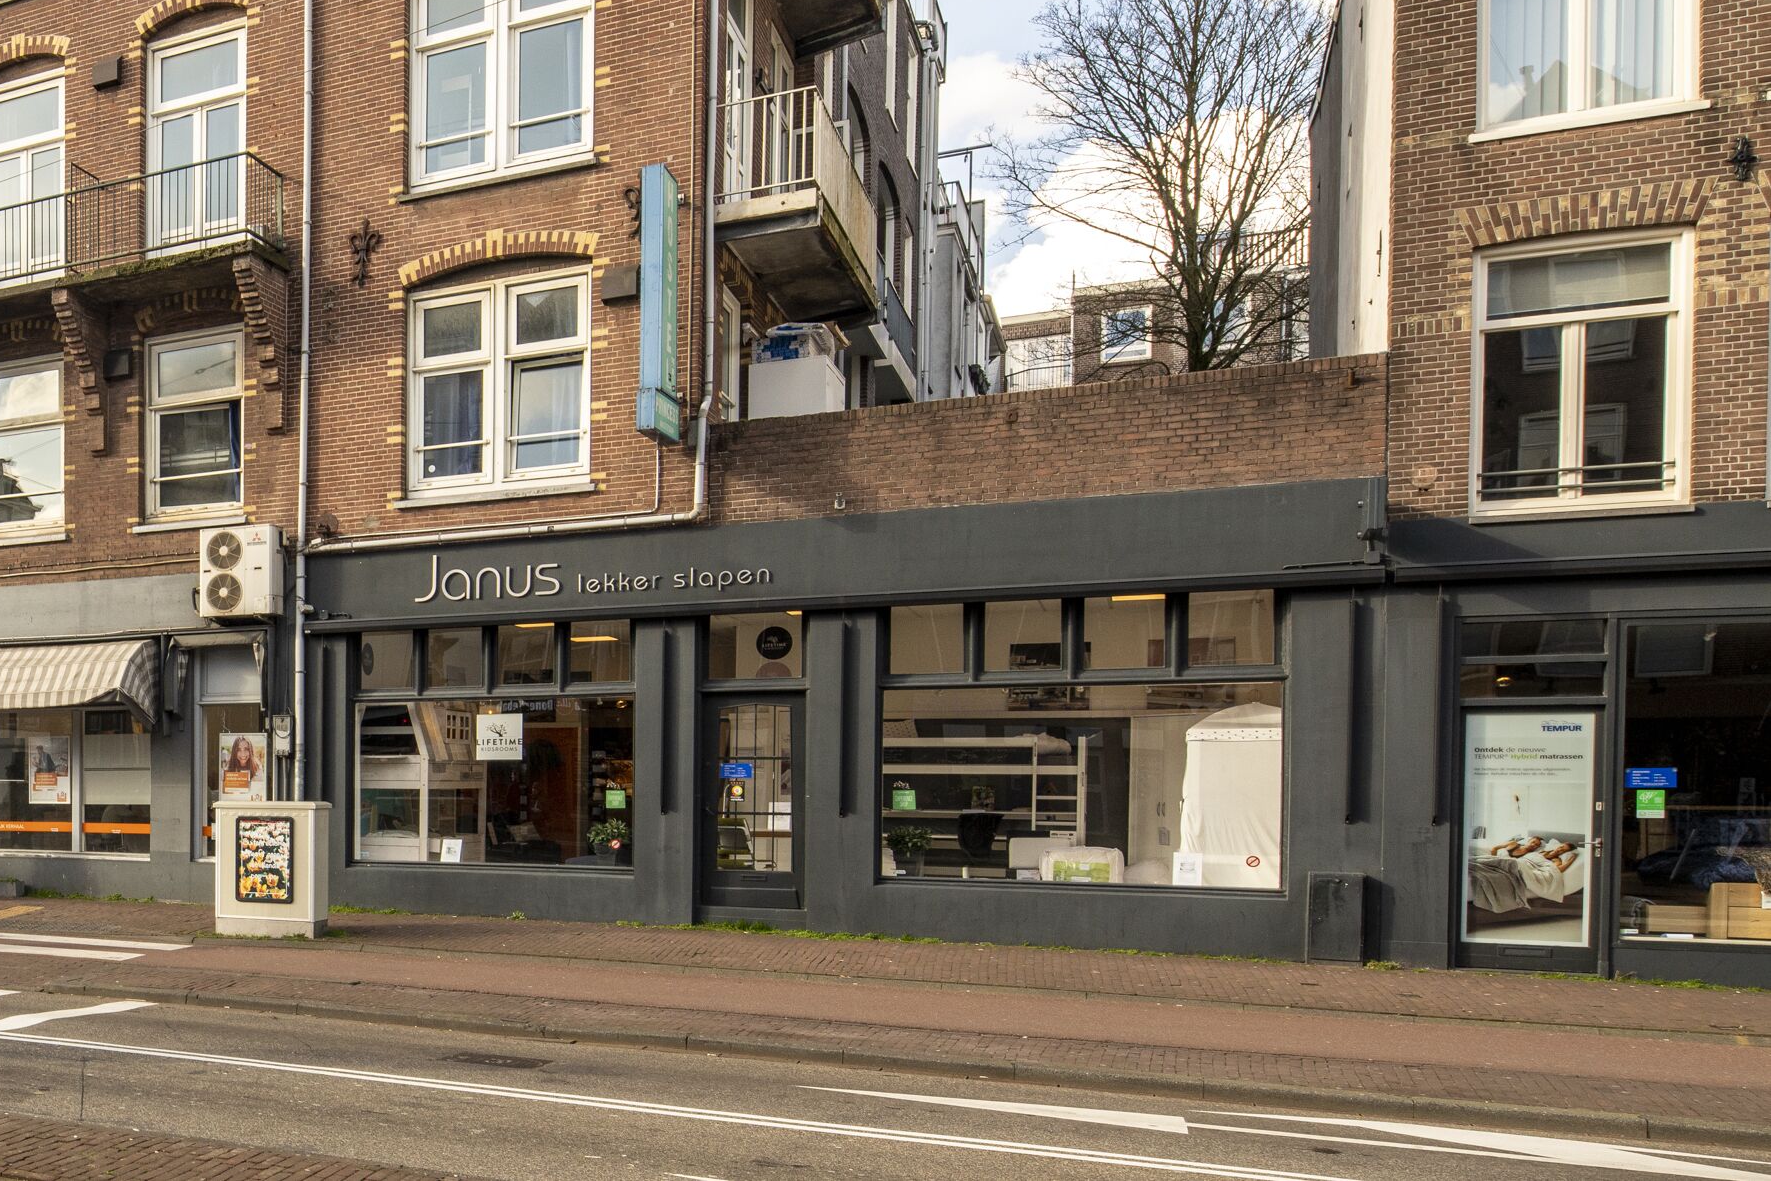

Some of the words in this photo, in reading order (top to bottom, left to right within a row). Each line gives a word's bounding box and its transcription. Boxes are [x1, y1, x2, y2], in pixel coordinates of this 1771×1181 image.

[414, 554, 562, 603] Janus
[578, 572, 661, 594] lekker
[673, 566, 771, 592] slapen
[1541, 724, 1583, 732] TEMPUR
[476, 738, 524, 746] LIFETIME
[1510, 753, 1538, 761] Hybrid
